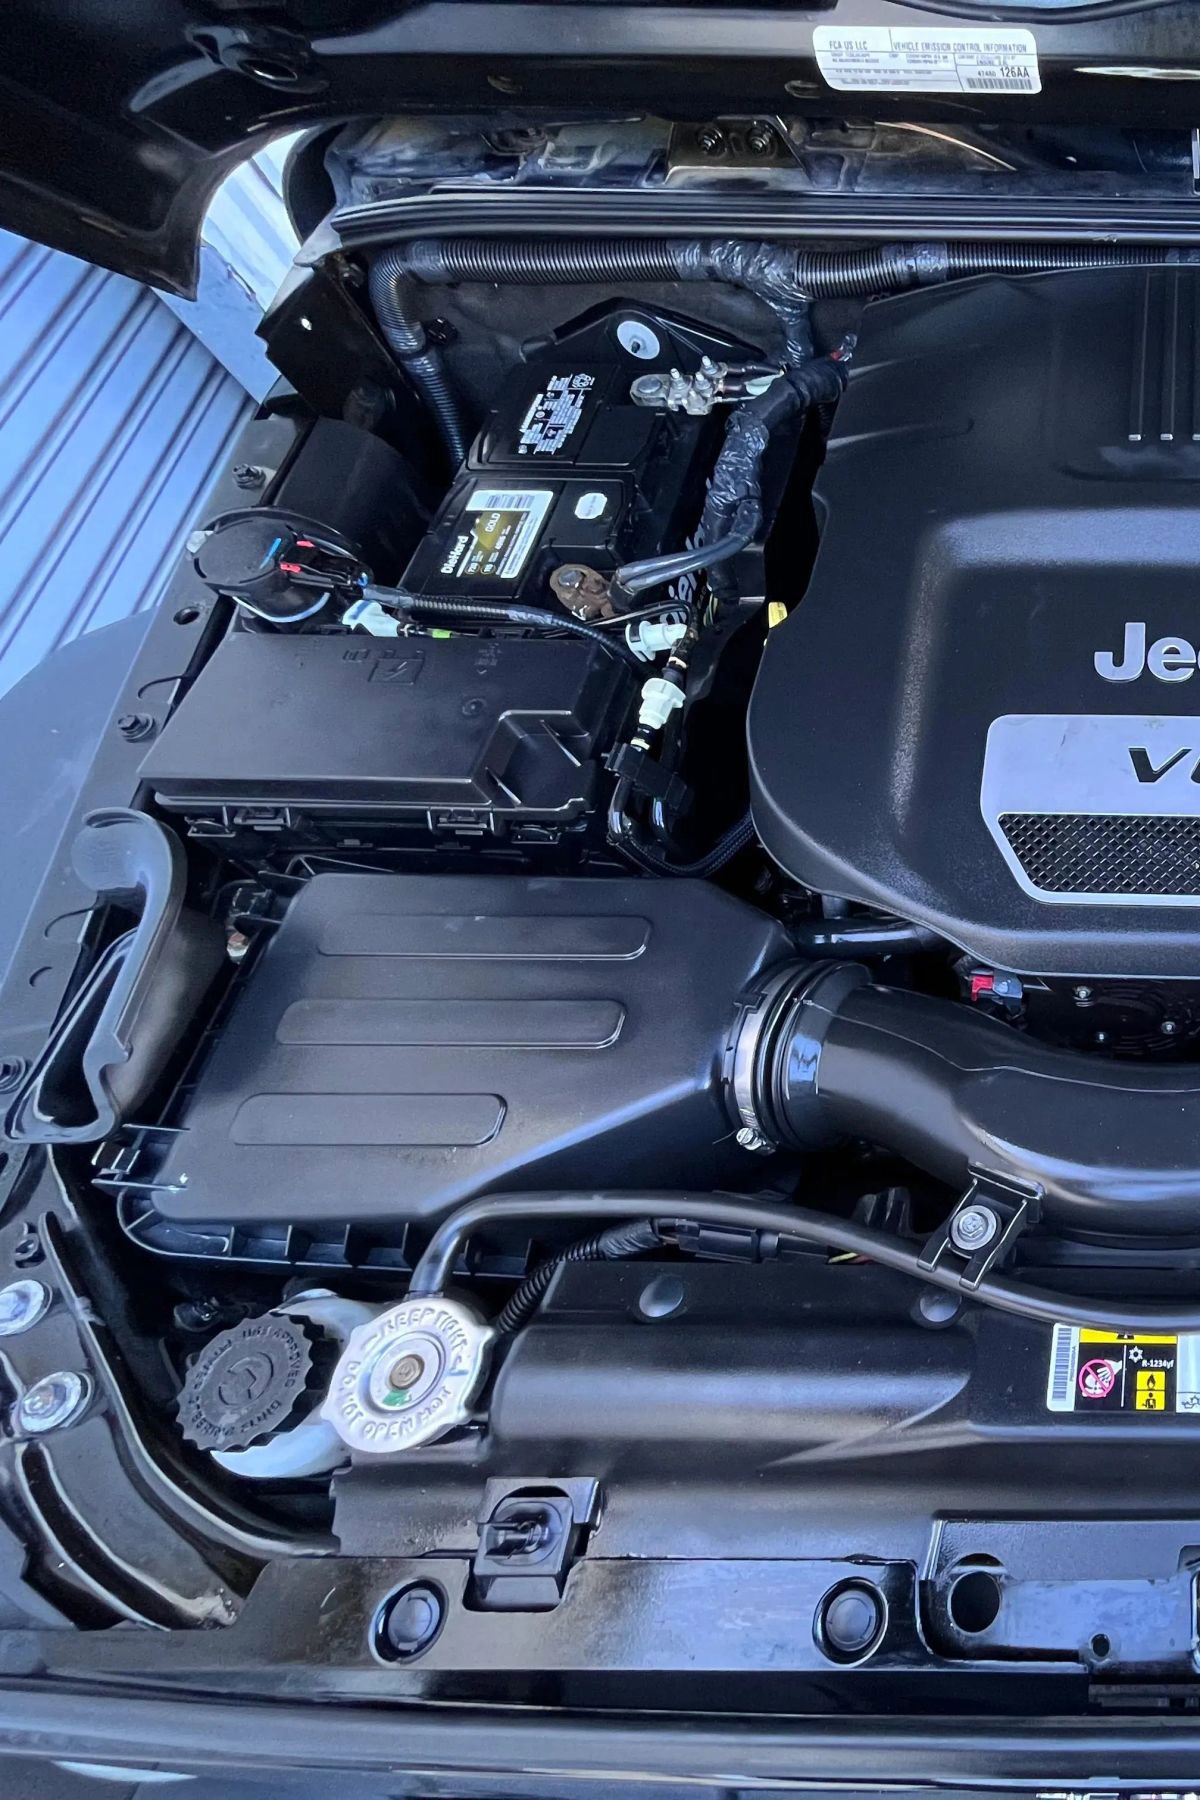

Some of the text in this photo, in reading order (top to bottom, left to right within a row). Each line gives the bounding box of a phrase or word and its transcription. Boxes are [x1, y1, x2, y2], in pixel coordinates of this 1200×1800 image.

[829, 40, 868, 50] FCA US LLC
[893, 41, 1027, 53] VEHICLE EMISSION CONTROL INFORMATION
[1000, 66, 1030, 78] 126AA
[485, 513, 500, 532] GOLD
[441, 536, 469, 574] DieHard
[378, 1307, 469, 1352] KEEP TIGHT
[1141, 1359, 1175, 1369] R-1234yf
[362, 1416, 414, 1441] OPEN
